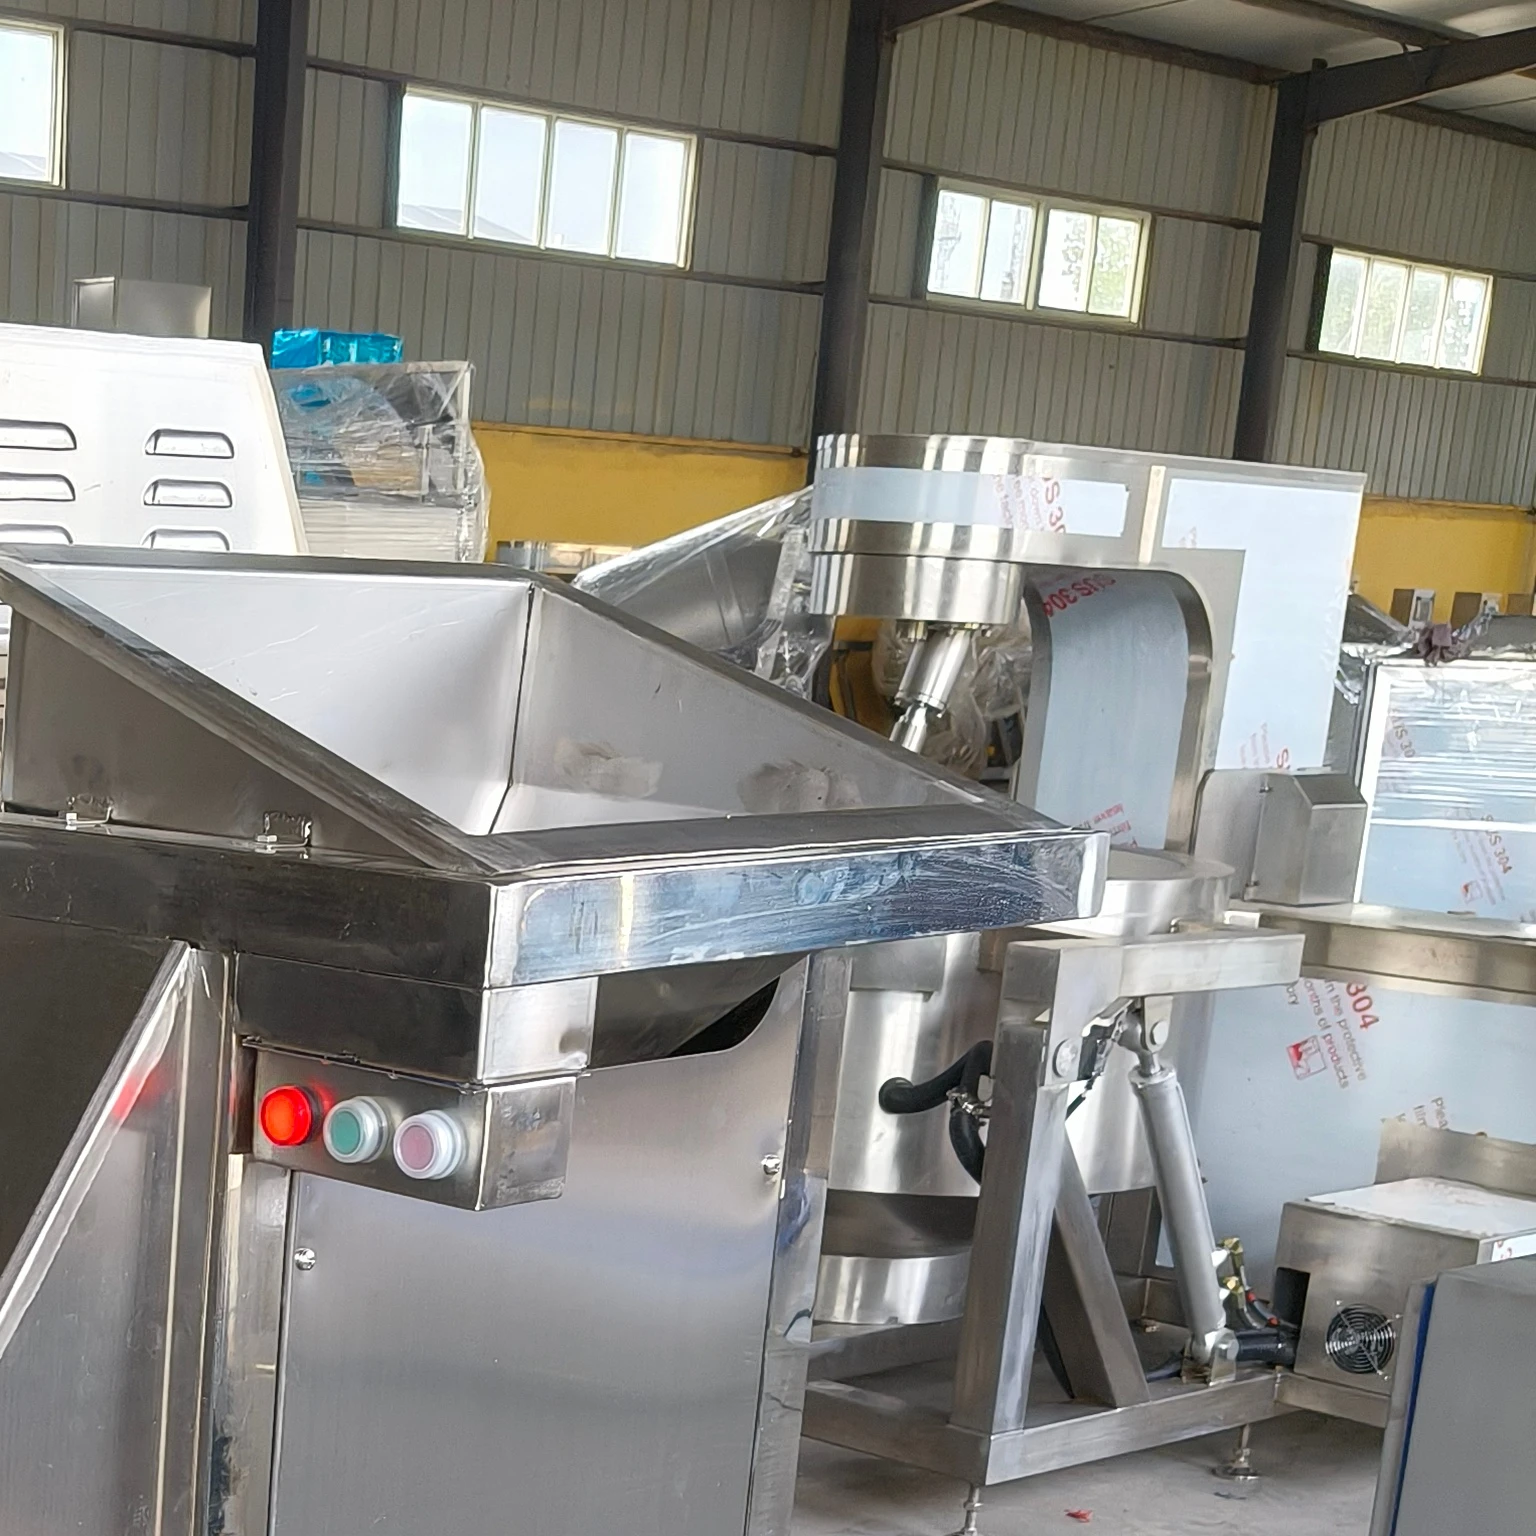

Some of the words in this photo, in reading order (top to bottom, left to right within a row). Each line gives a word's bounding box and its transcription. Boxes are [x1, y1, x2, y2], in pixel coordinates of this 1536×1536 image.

[1330, 994, 1344, 1017] the
[1346, 981, 1380, 1030] 304
[1303, 980, 1324, 1016] onths
[1321, 1033, 1350, 1088] products
[1336, 1018, 1367, 1081] protective
[1431, 1097, 1448, 1128] Plea
